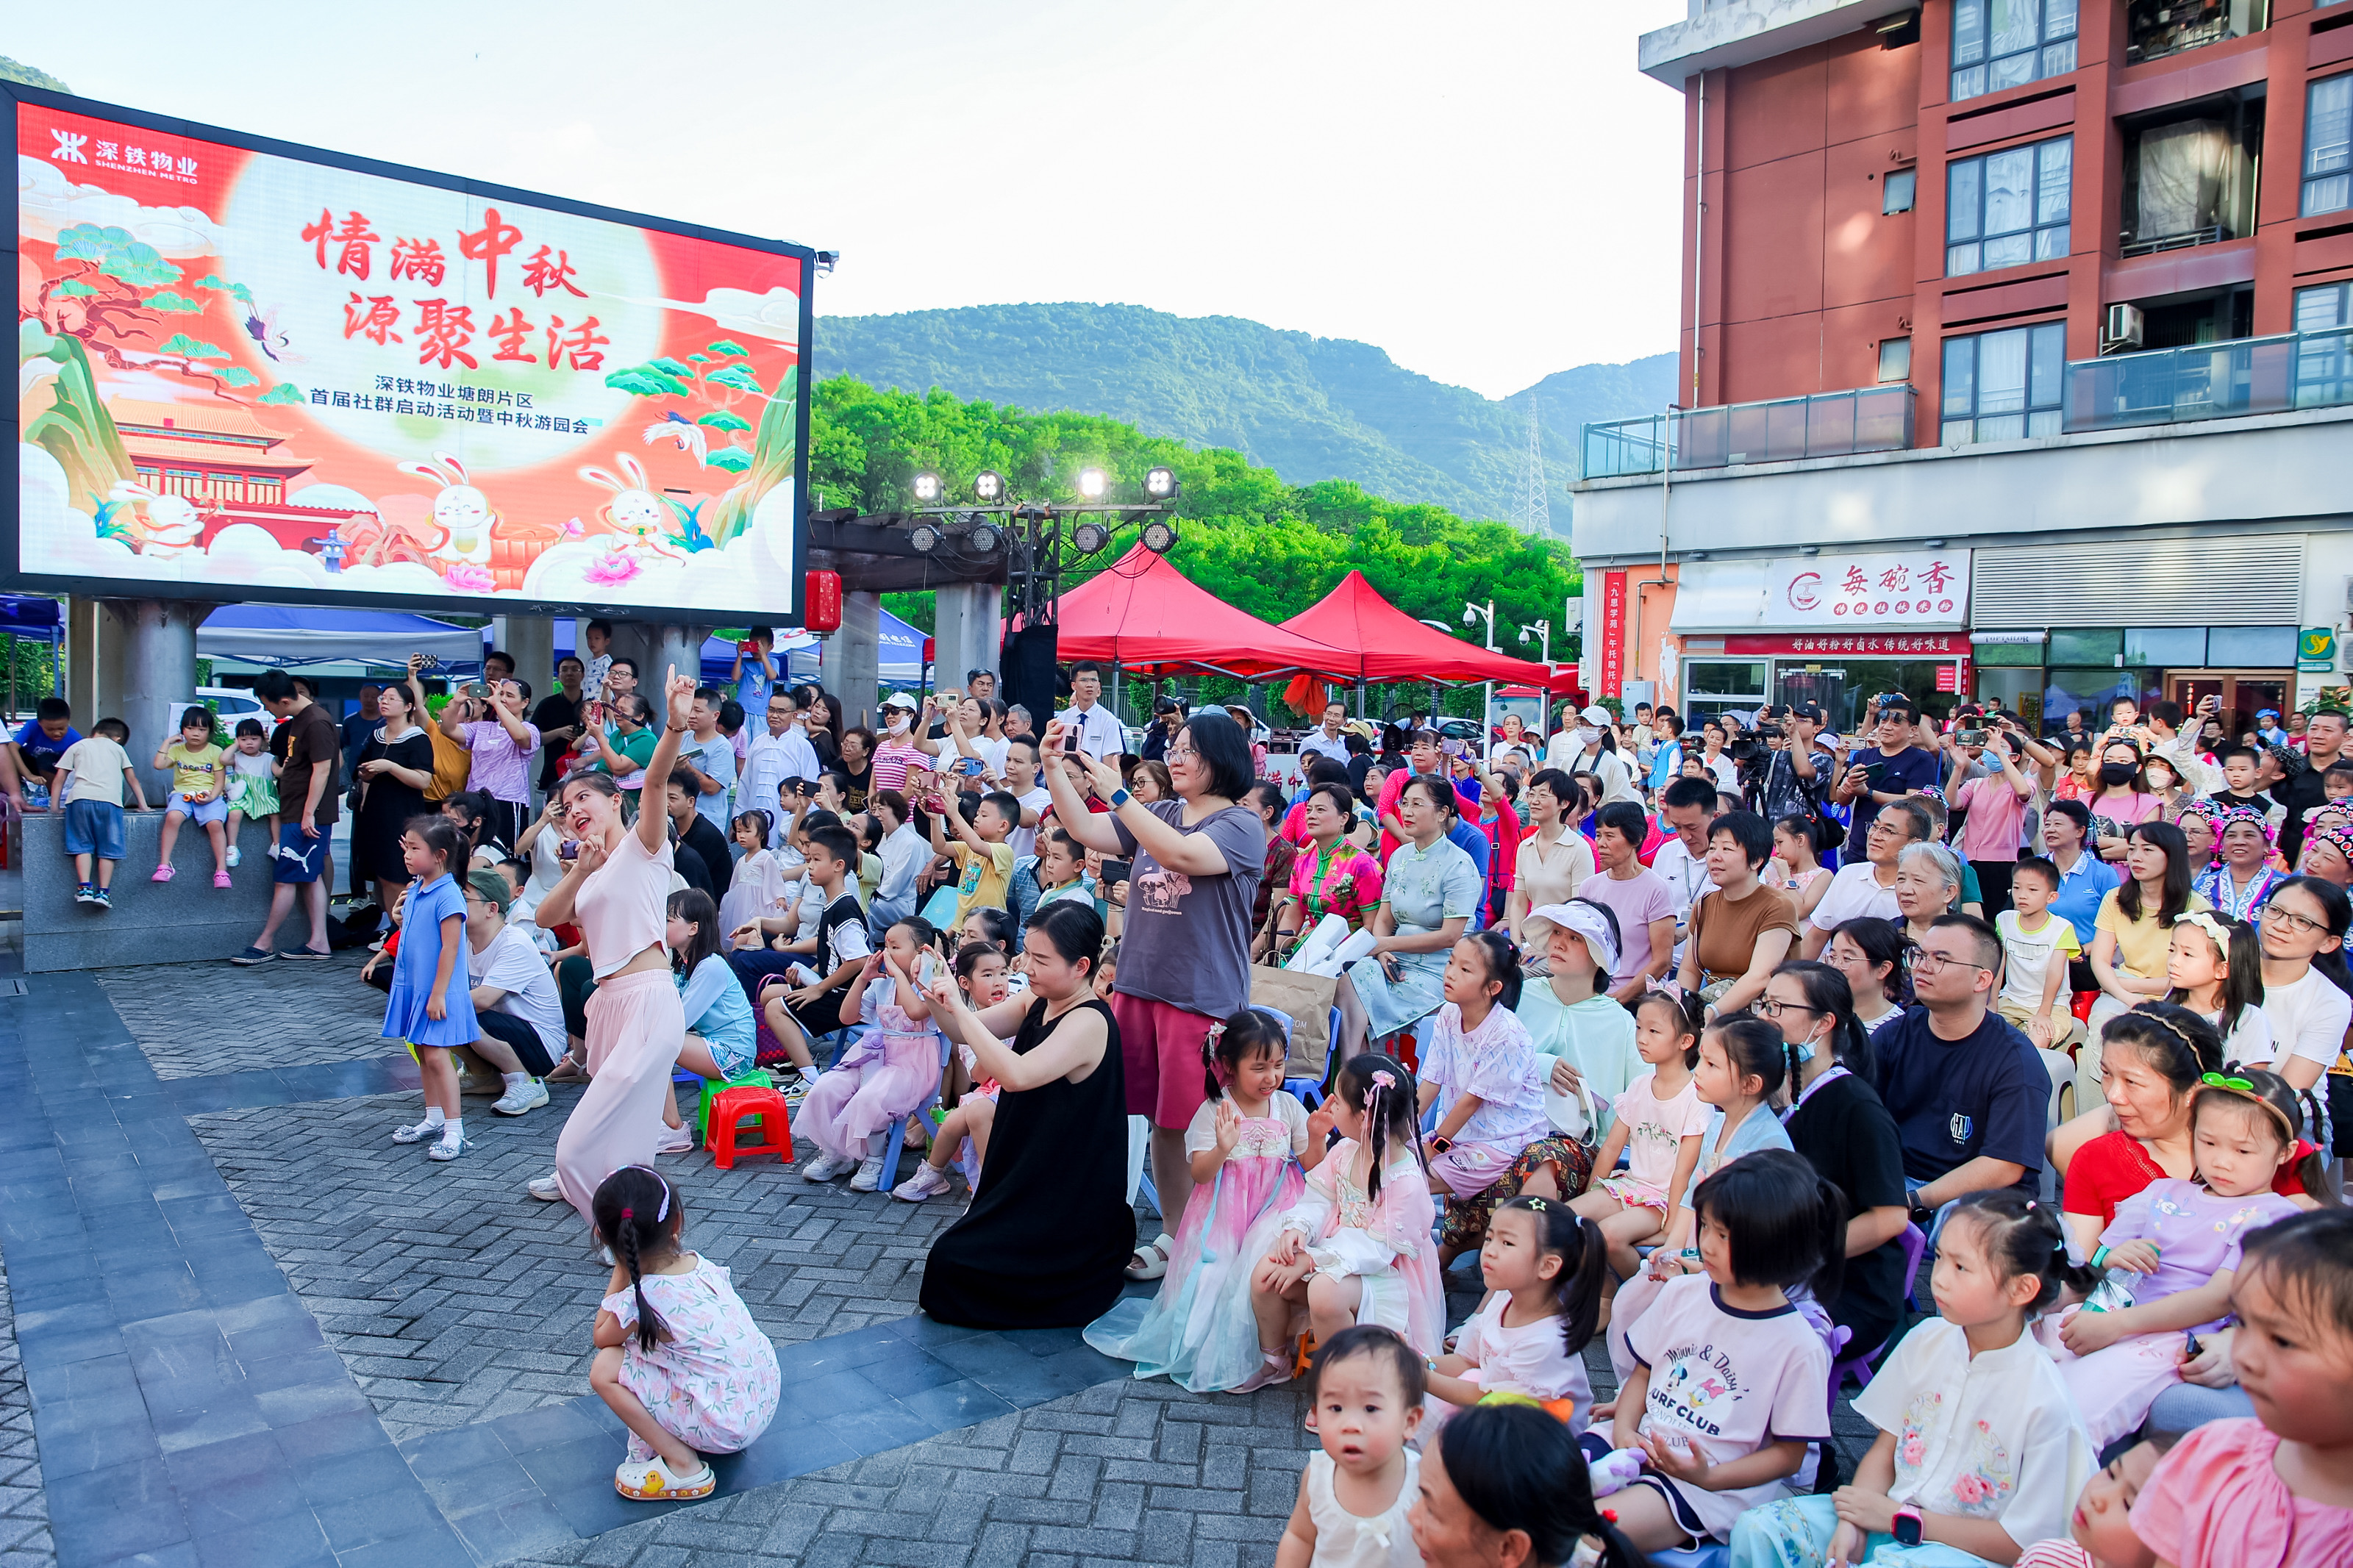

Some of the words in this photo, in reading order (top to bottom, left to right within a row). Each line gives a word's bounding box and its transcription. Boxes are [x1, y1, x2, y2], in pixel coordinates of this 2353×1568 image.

[95, 160, 157, 177] SHENZHEN
[160, 172, 199, 185] METRO
[96, 139, 199, 178] 深铁物业
[301, 207, 590, 300] 情满中秋
[343, 291, 611, 371] 源聚生活
[375, 374, 535, 409] 深铁物业塘朗片区
[310, 388, 590, 435] 首届社群启动活动暨中秋游园会
[1840, 561, 1956, 597] 每碗香
[1835, 600, 1953, 615] 传统桂林米粉
[1792, 637, 1879, 652] 好油好粉好卤水
[1883, 636, 1951, 653] 传统好味道
[1950, 1112, 1973, 1141] GAP
[1699, 1344, 1713, 1361] &
[1713, 1352, 1750, 1401] Daisy's
[1676, 1405, 1721, 1436] CLUB
